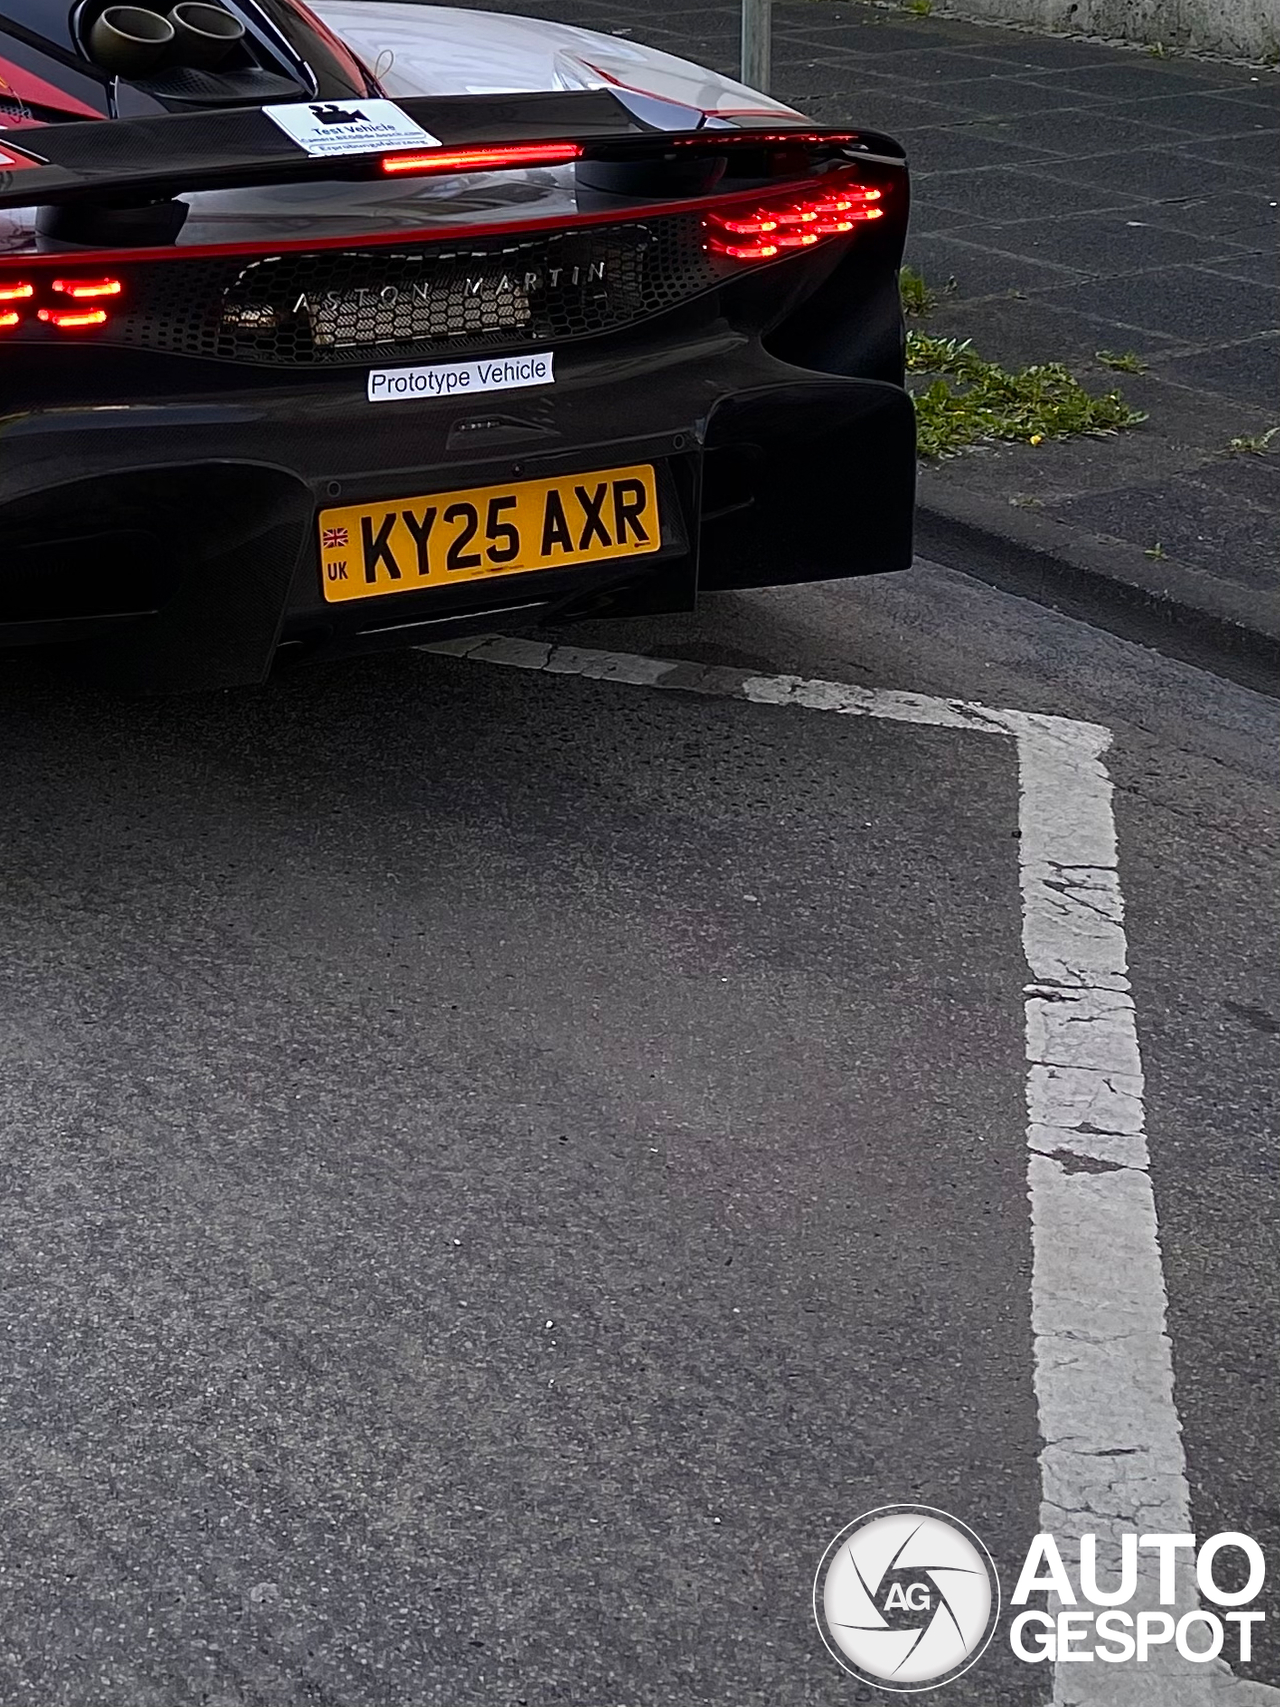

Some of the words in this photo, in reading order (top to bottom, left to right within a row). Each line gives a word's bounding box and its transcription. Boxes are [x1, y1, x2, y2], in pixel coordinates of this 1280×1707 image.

[312, 127, 345, 136] Test
[345, 123, 396, 134] Vehicle
[292, 281, 429, 313] ASTON
[464, 261, 605, 295] MARTIN
[371, 368, 470, 395] Prototype
[477, 359, 546, 385] Vehicle
[361, 495, 521, 584] KY25
[540, 478, 650, 557] AXR
[327, 561, 349, 582] UK
